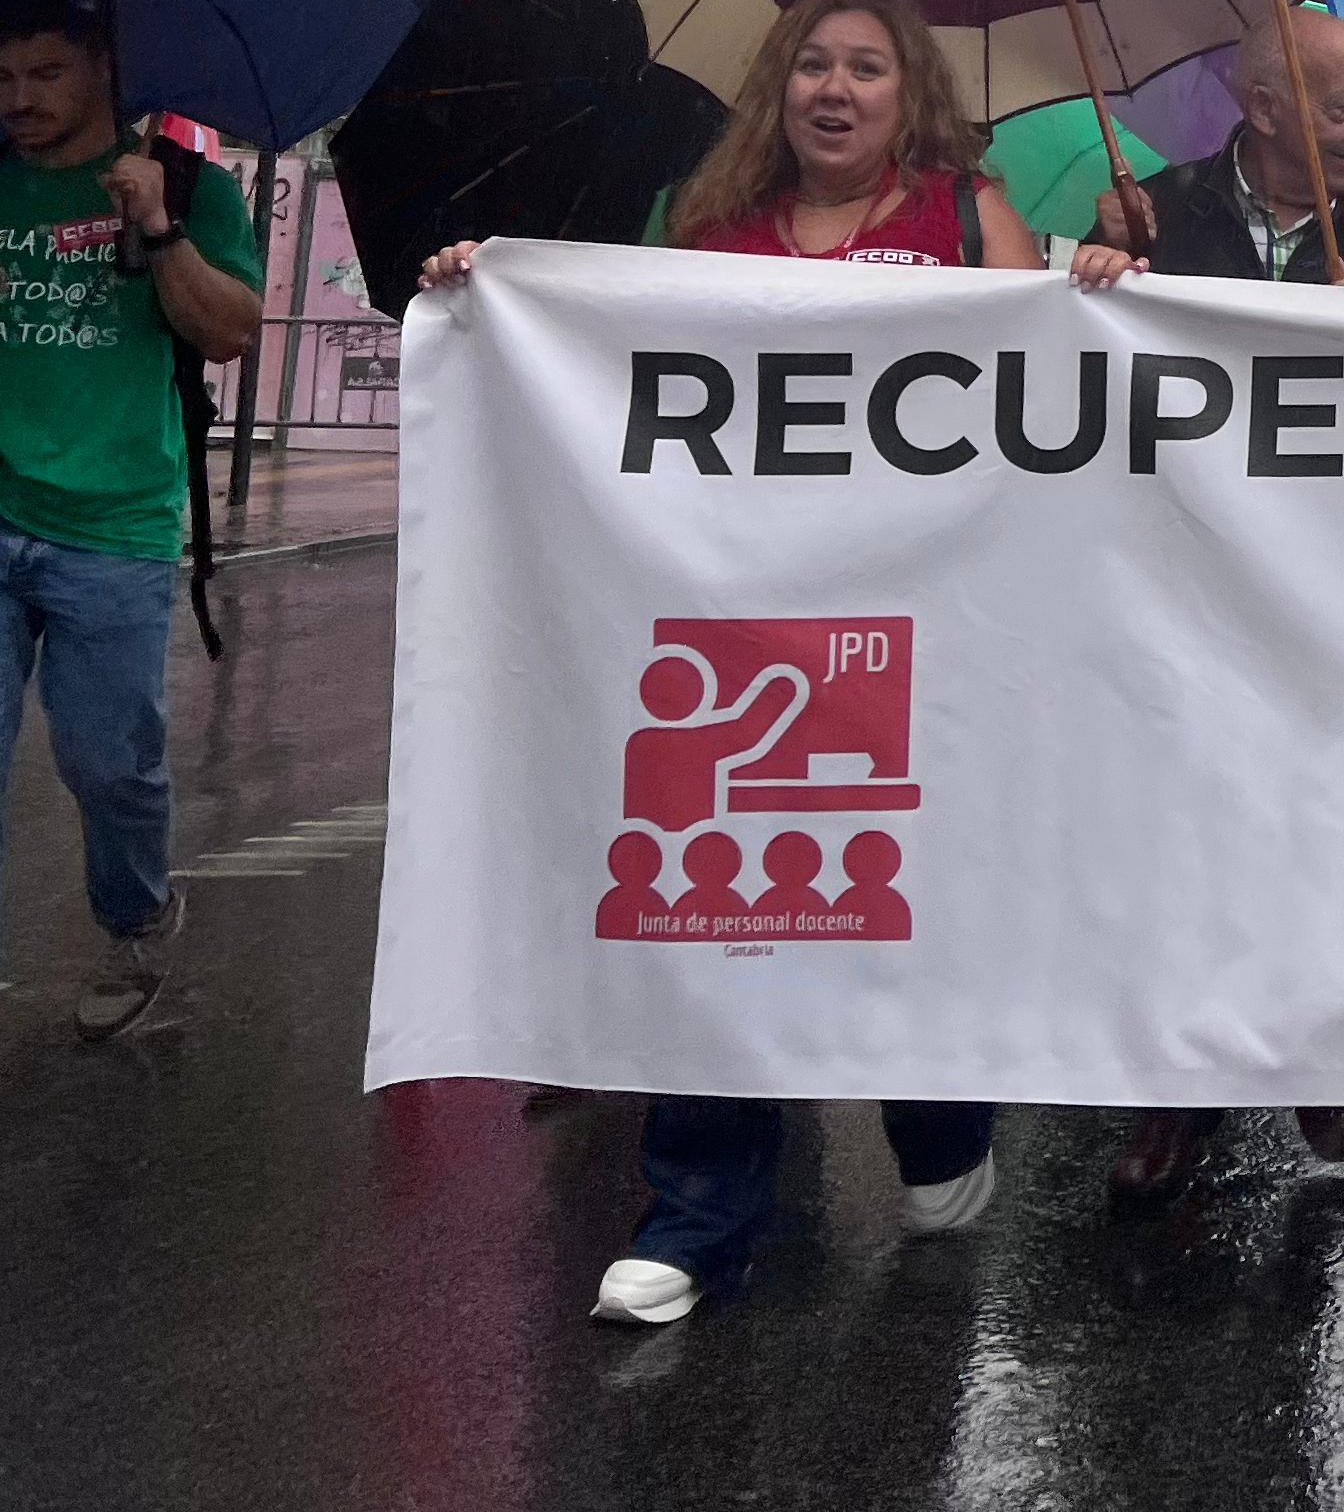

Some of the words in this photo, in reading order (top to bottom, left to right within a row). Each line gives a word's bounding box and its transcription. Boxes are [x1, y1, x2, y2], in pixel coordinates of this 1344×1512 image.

[851, 250, 914, 264] CCOO
[822, 631, 890, 684] JPD
[636, 909, 681, 935] Junta
[685, 909, 709, 934] de
[712, 909, 790, 936] personal
[794, 910, 866, 934] docente
